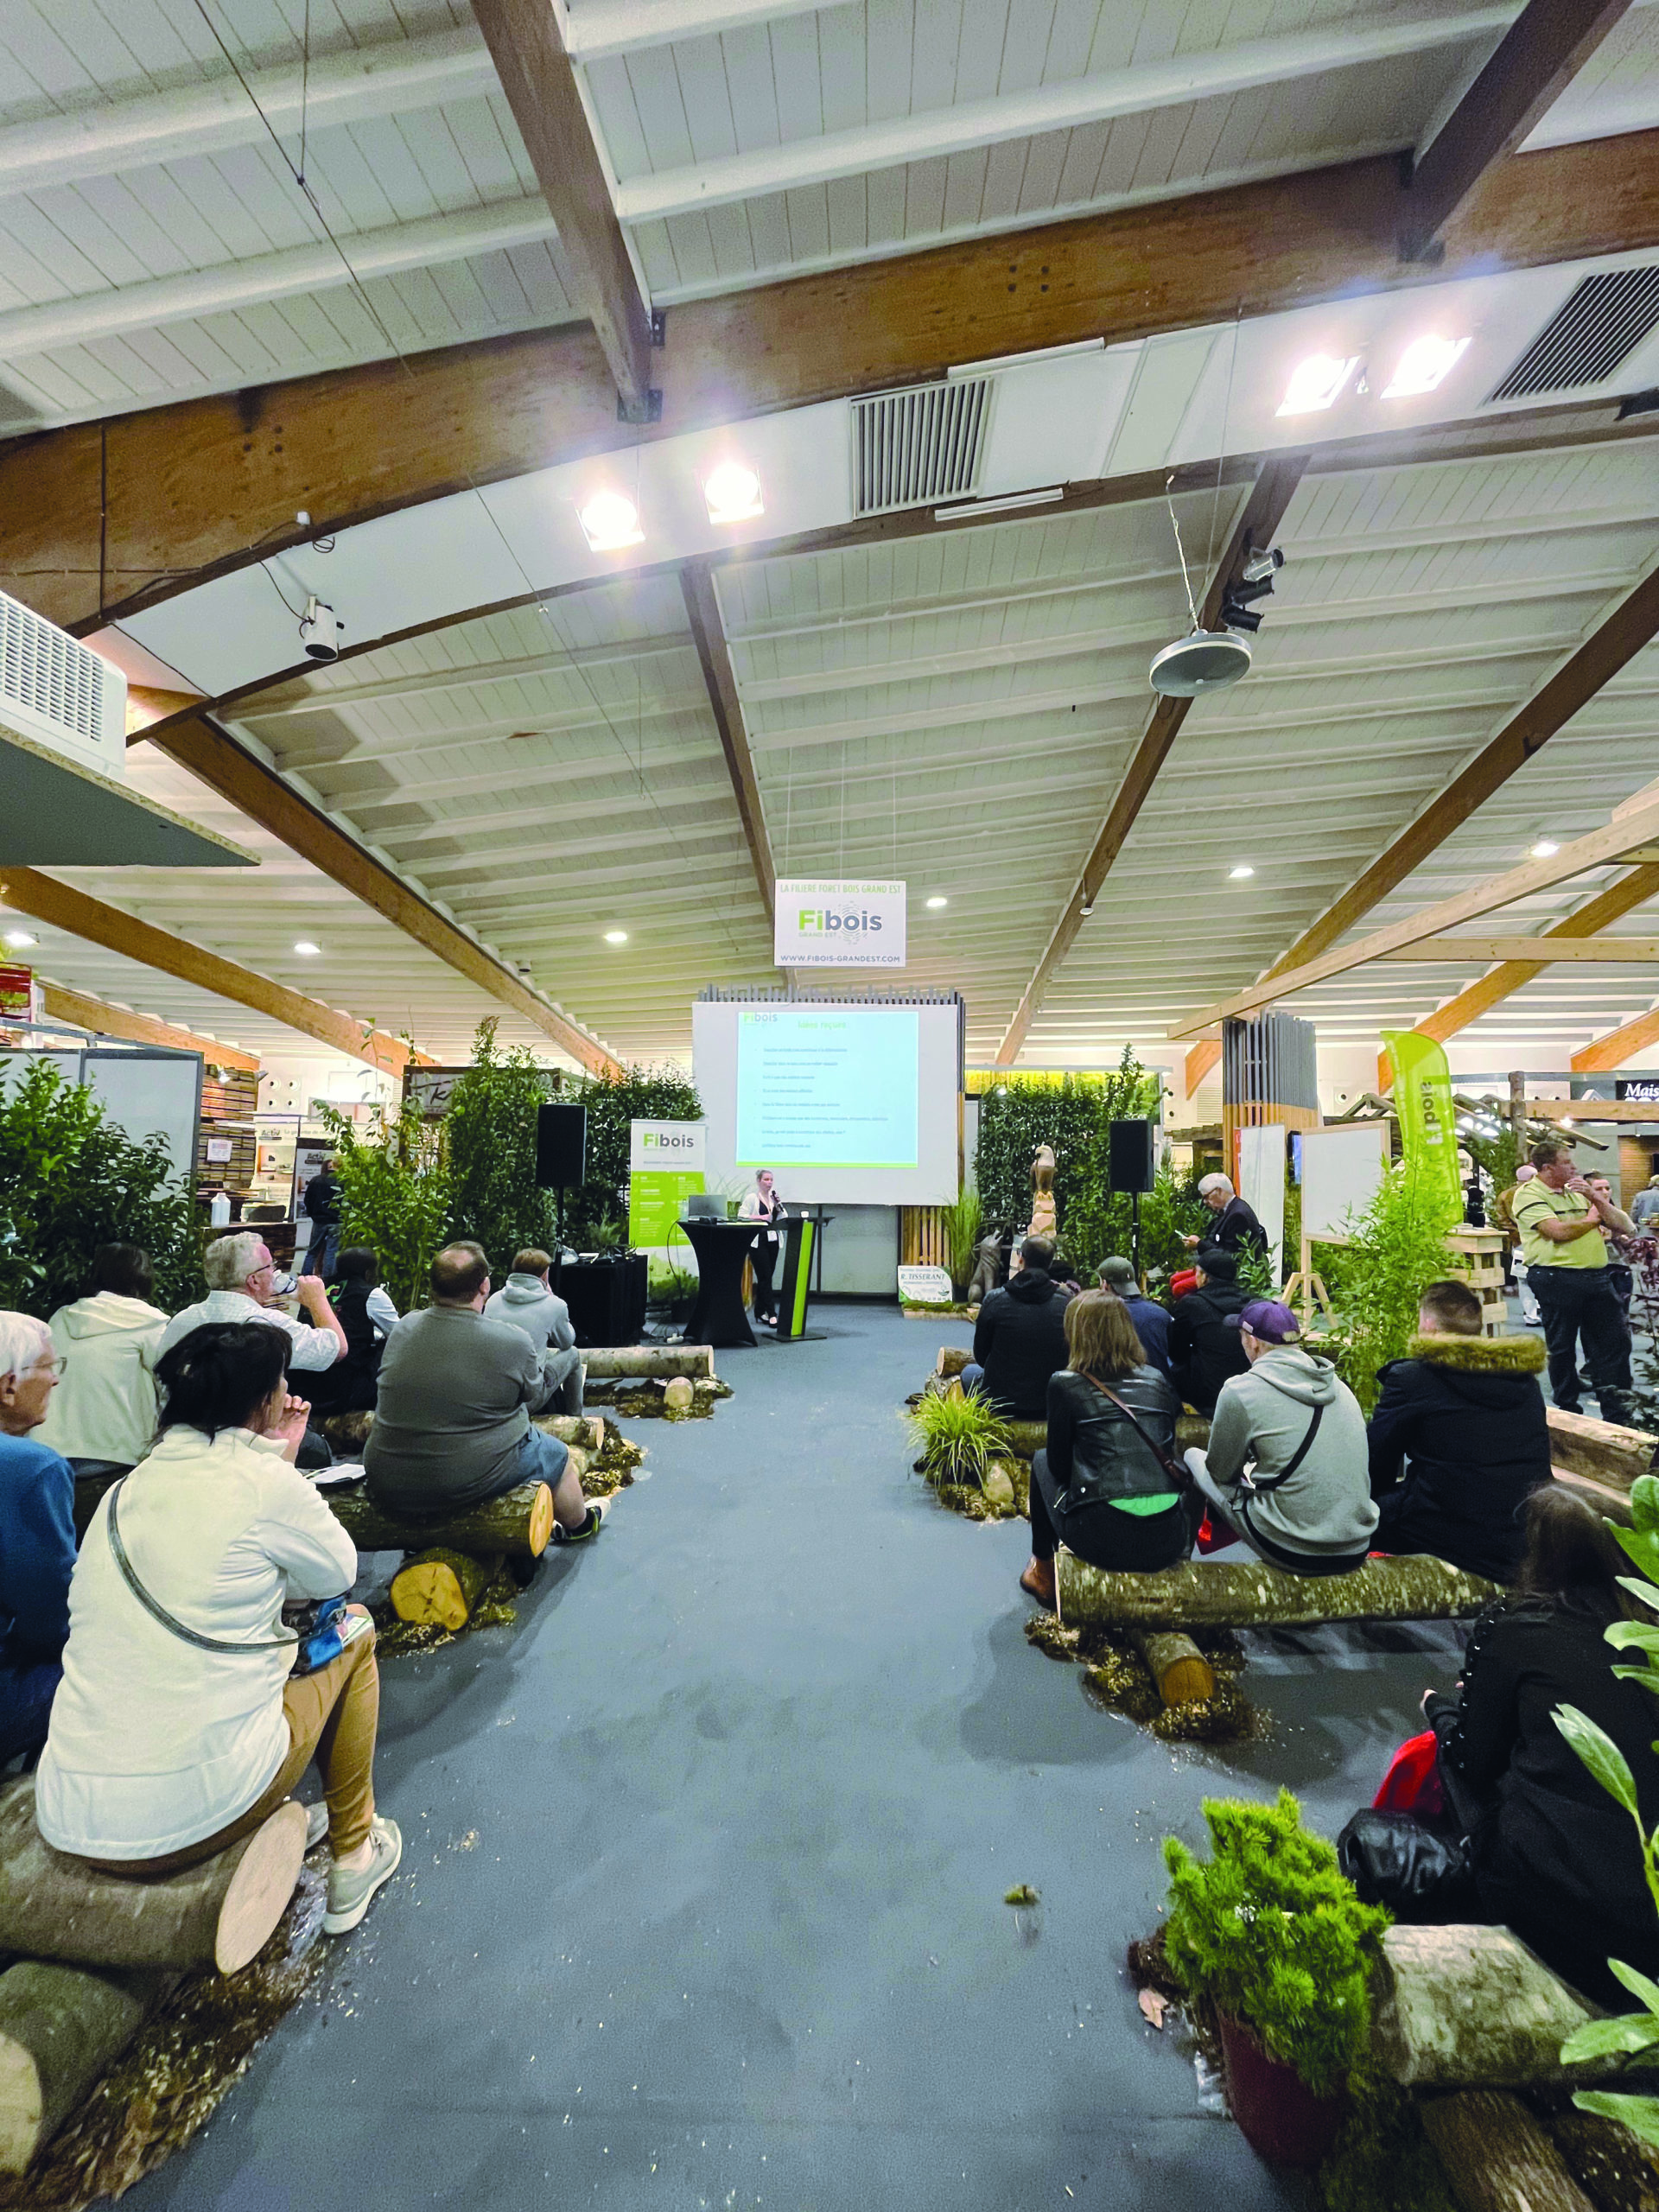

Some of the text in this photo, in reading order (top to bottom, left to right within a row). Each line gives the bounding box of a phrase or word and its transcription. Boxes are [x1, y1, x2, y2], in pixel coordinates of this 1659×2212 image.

[780, 884, 790, 893] LA
[842, 885, 860, 893] BOIS
[861, 885, 887, 893] GRAND
[888, 885, 901, 893] EST
[798, 910, 882, 931] Fibois
[744, 1011, 778, 1022] Fibois
[643, 1133, 695, 1147] Fibois
